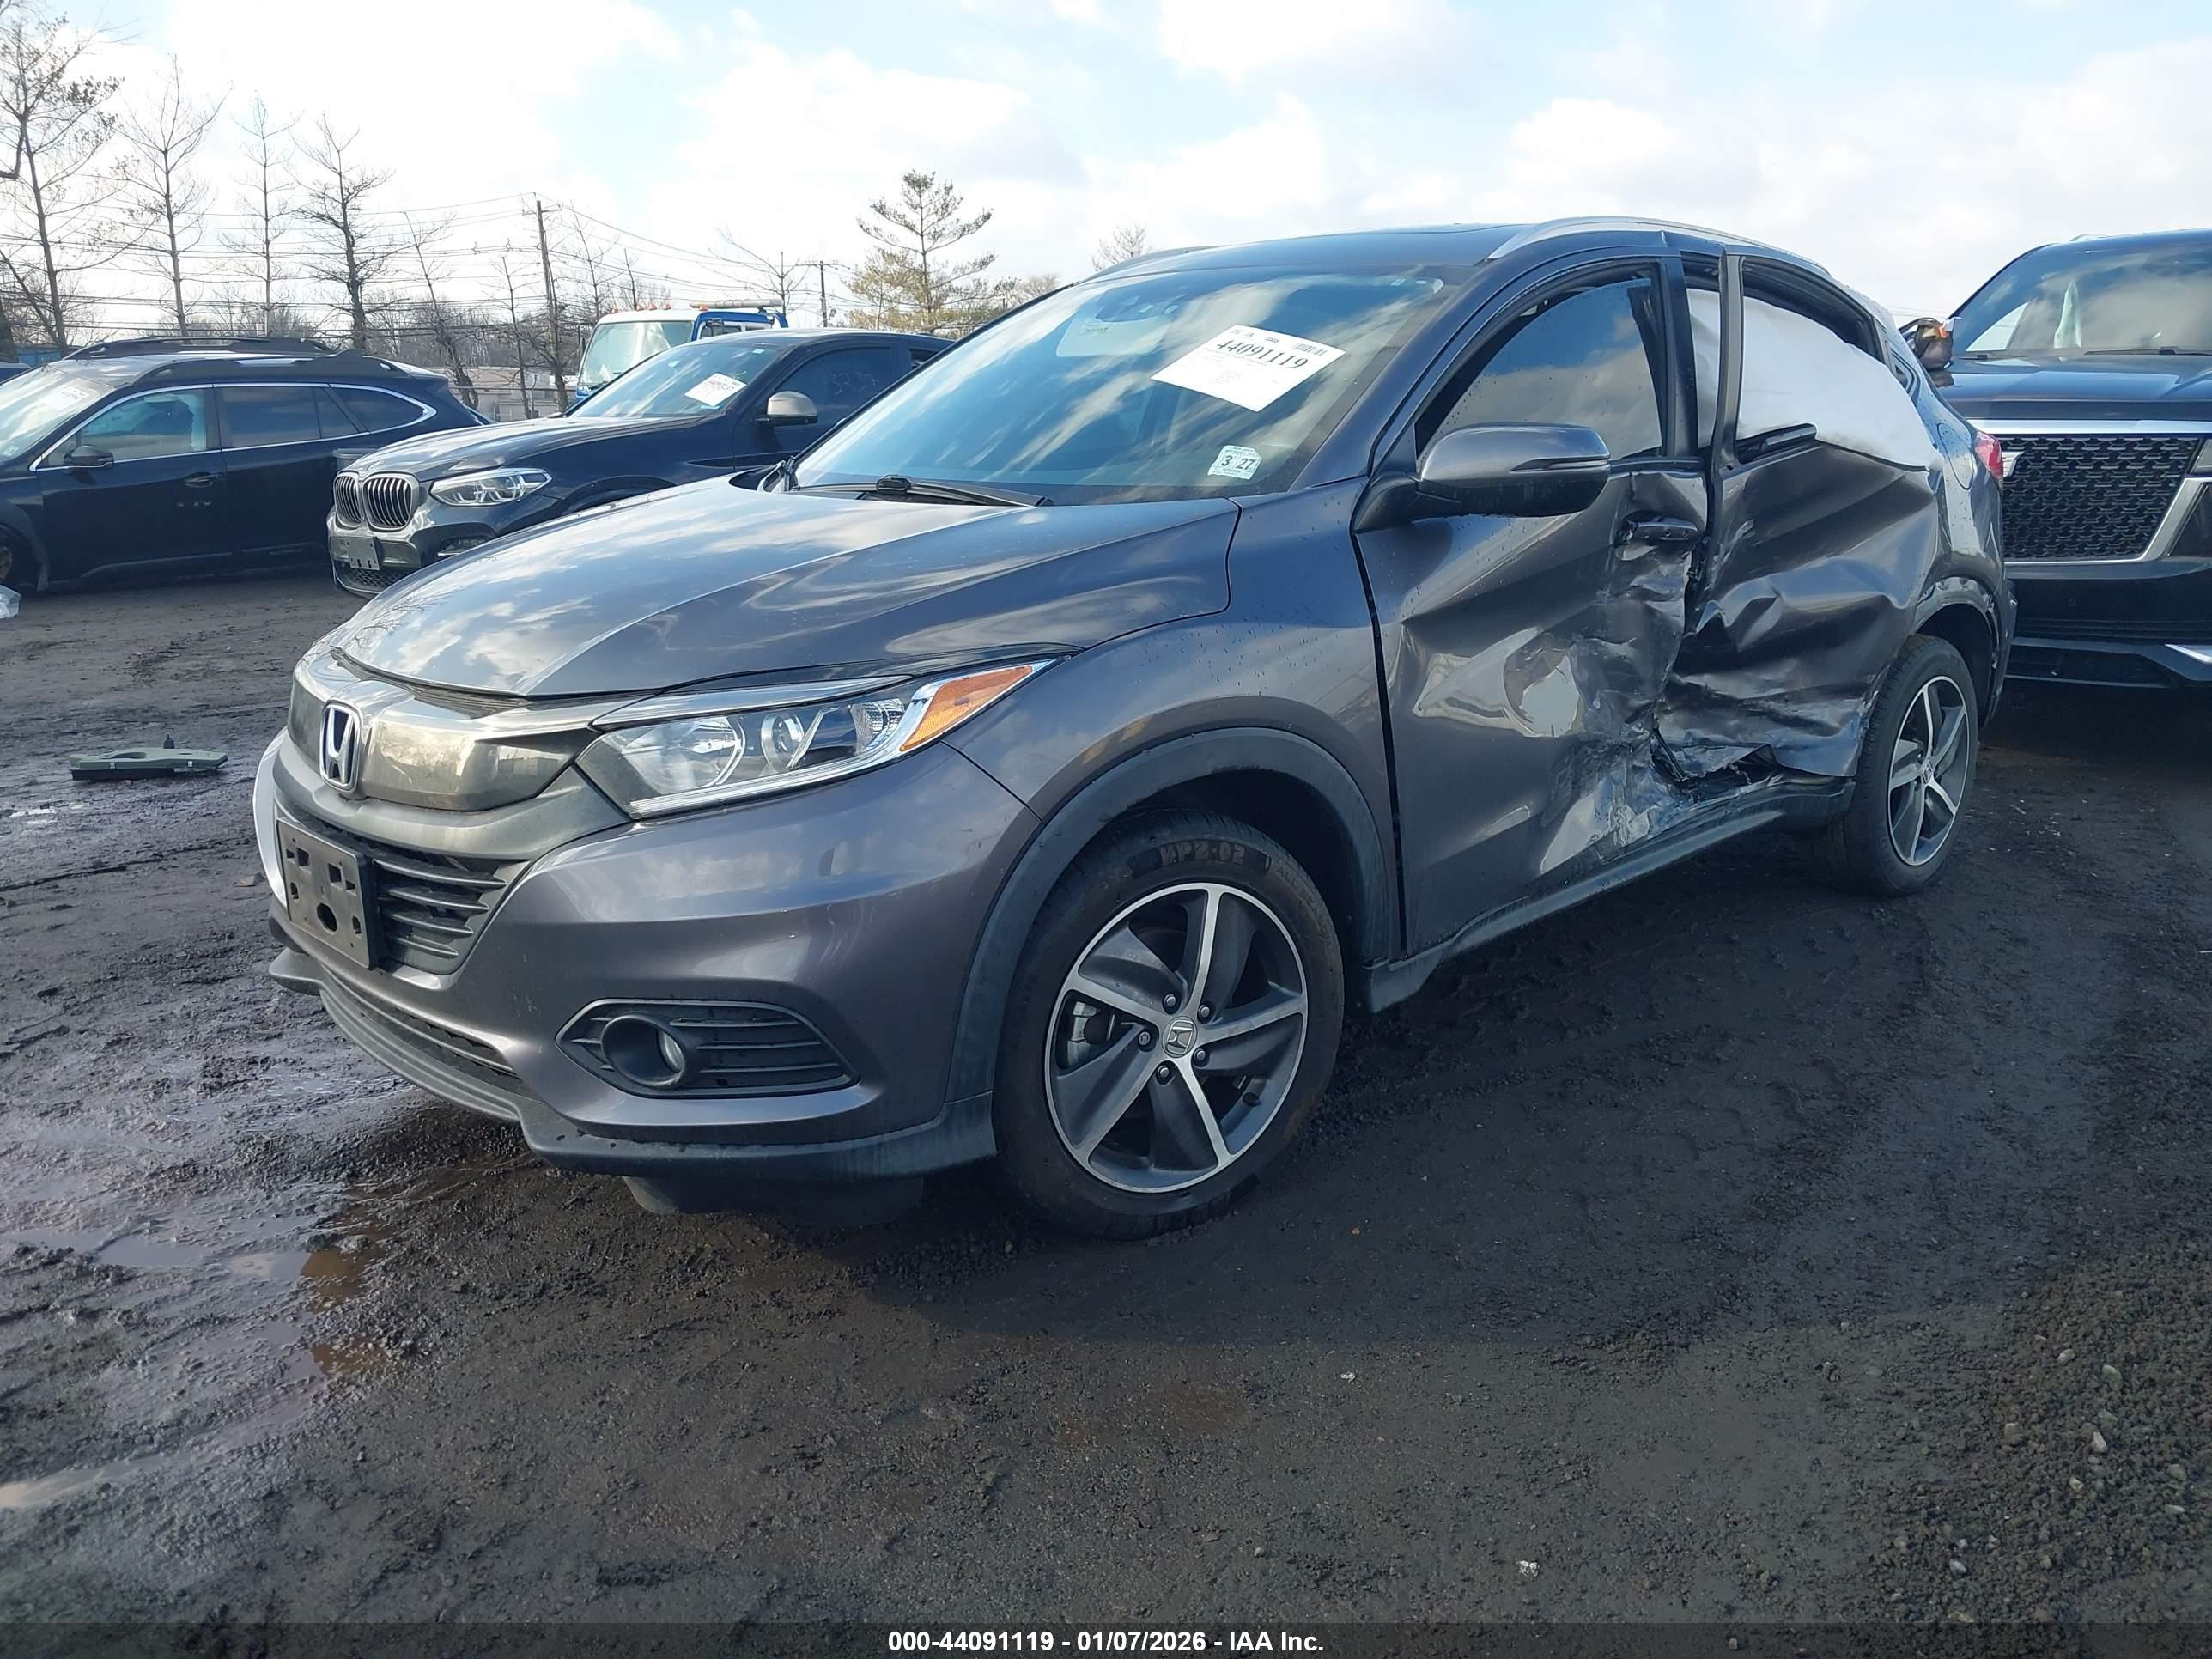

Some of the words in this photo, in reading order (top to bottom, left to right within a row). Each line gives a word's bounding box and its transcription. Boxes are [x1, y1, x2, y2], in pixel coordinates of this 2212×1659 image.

[1216, 338, 1309, 369] 44091119
[1221, 455, 1233, 467] 3
[1235, 458, 1257, 470] 27
